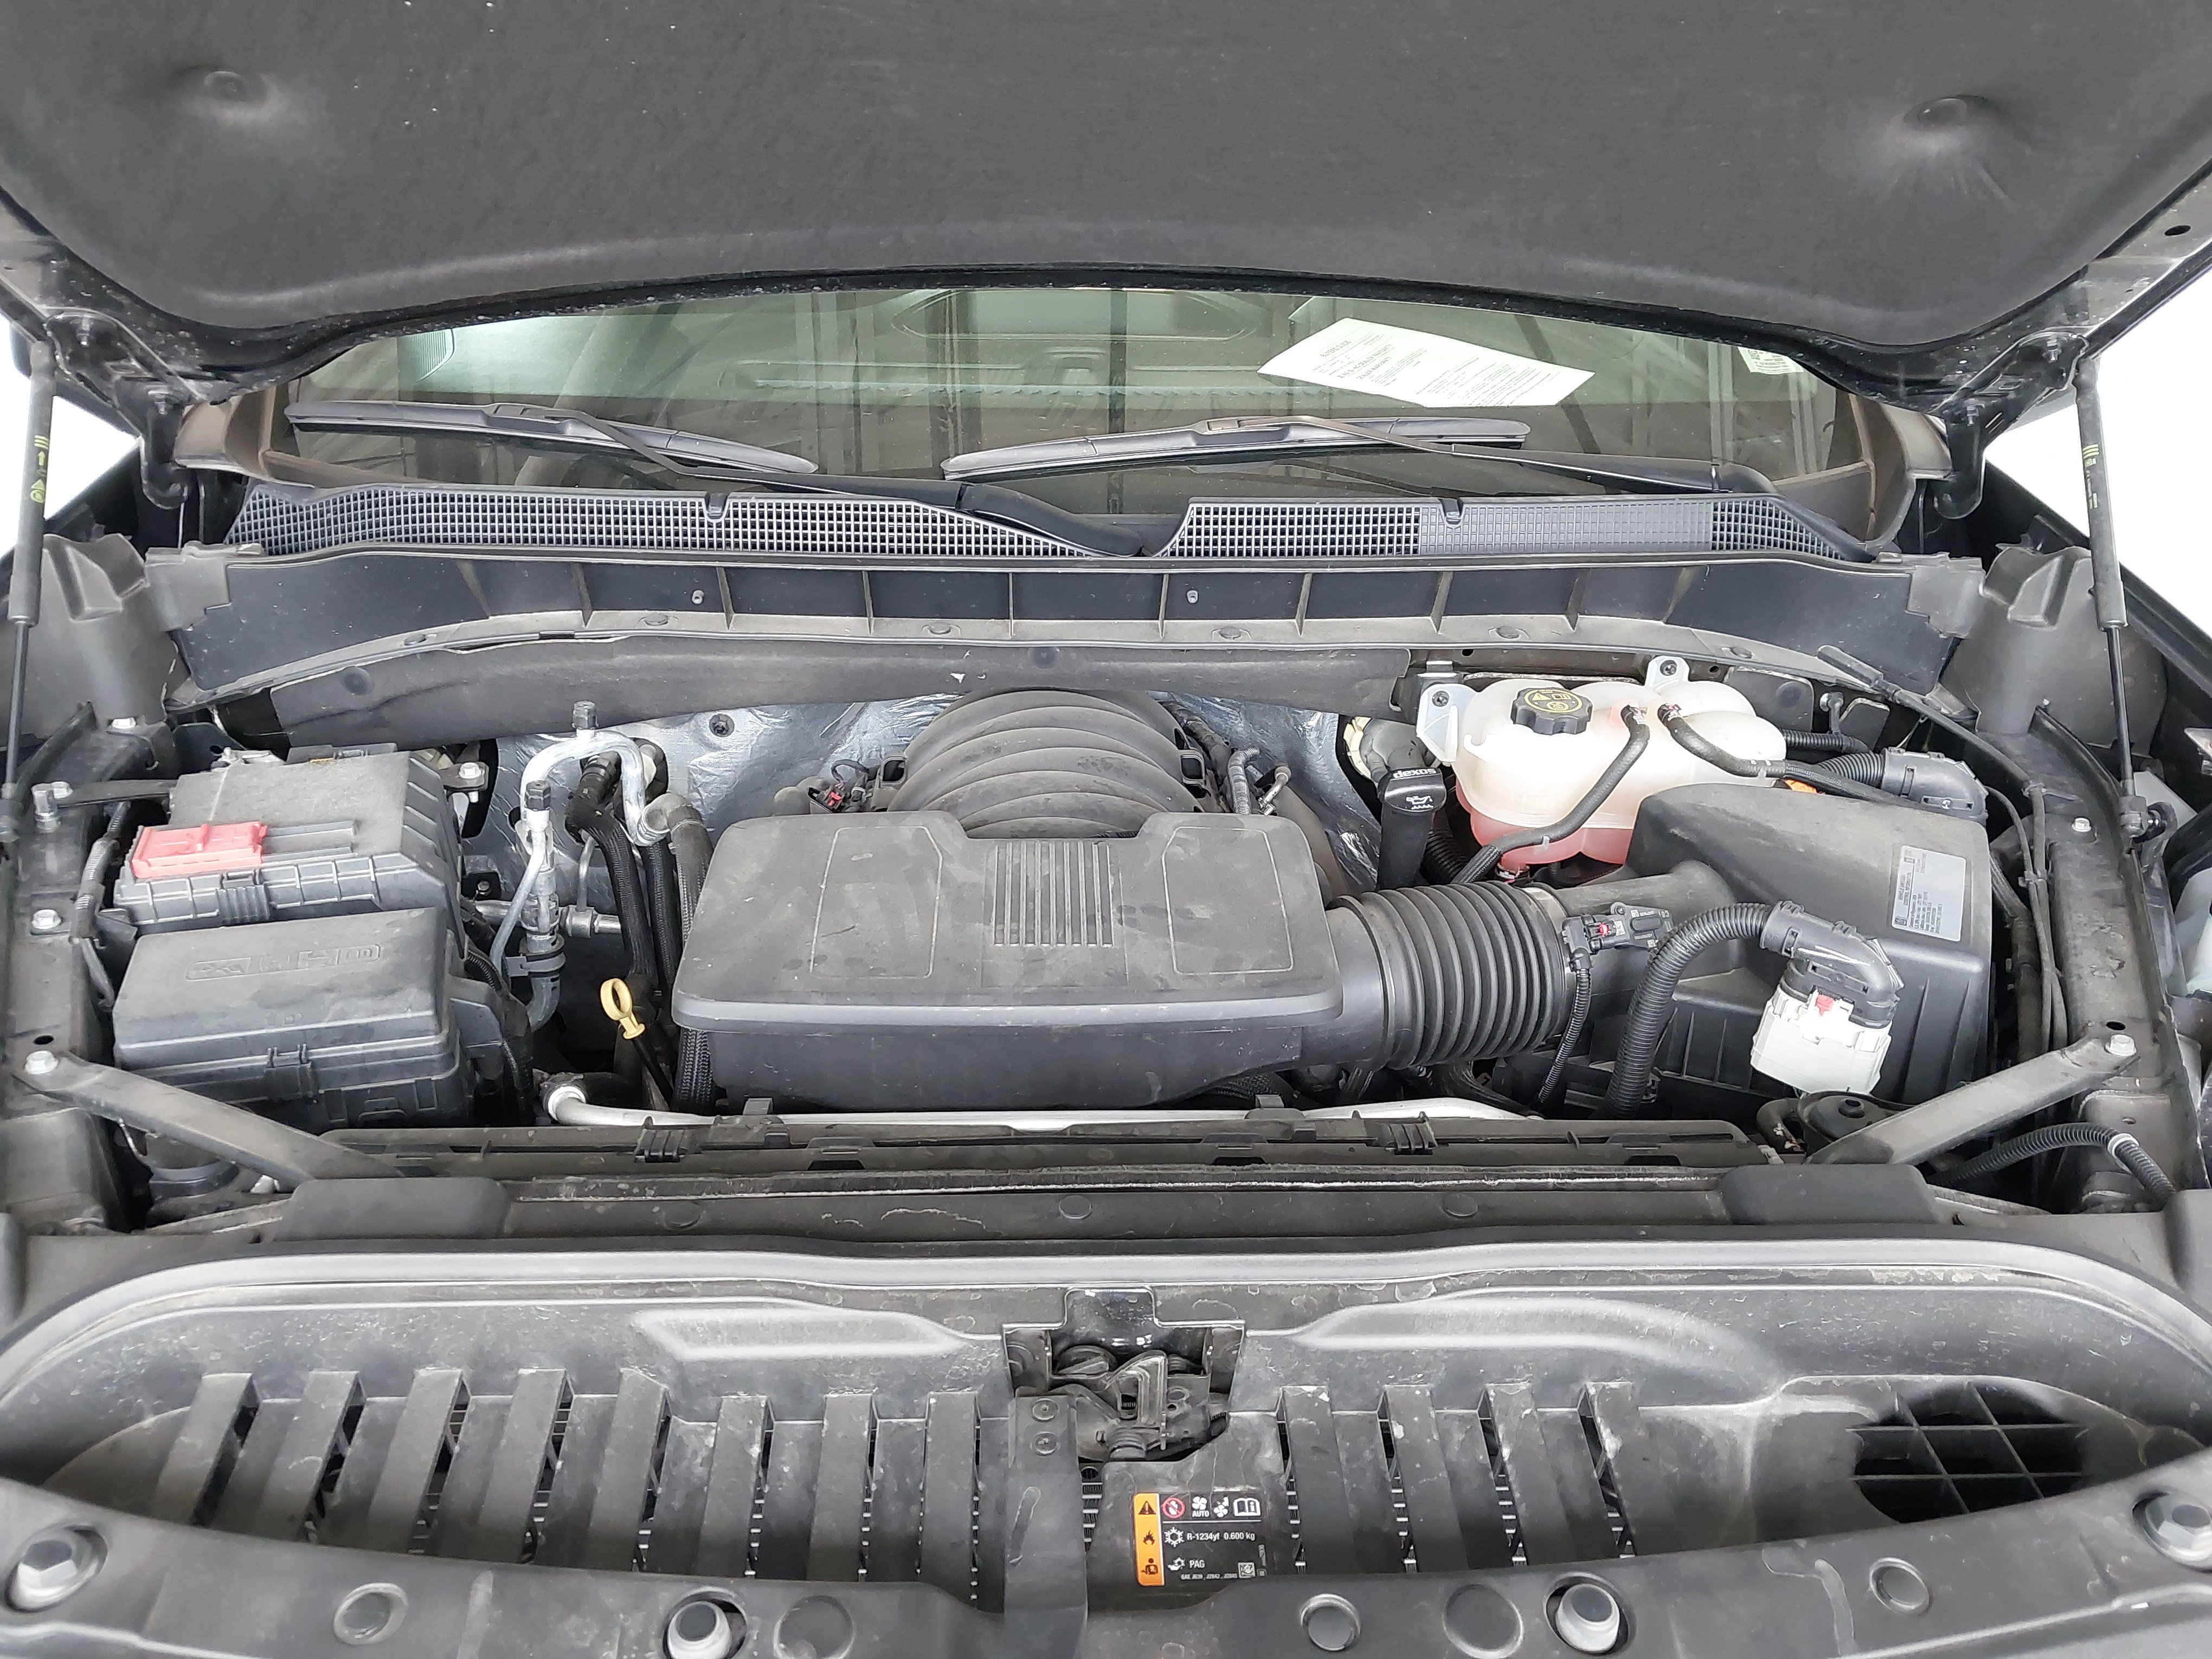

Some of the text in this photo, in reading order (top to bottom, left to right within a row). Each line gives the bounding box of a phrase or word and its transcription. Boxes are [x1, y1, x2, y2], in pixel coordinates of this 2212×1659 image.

[1393, 768, 1437, 779] dexos
[1187, 1532, 1256, 1542] R-1234yf 0.600 kg
[1189, 1559, 1205, 1568] PAG
